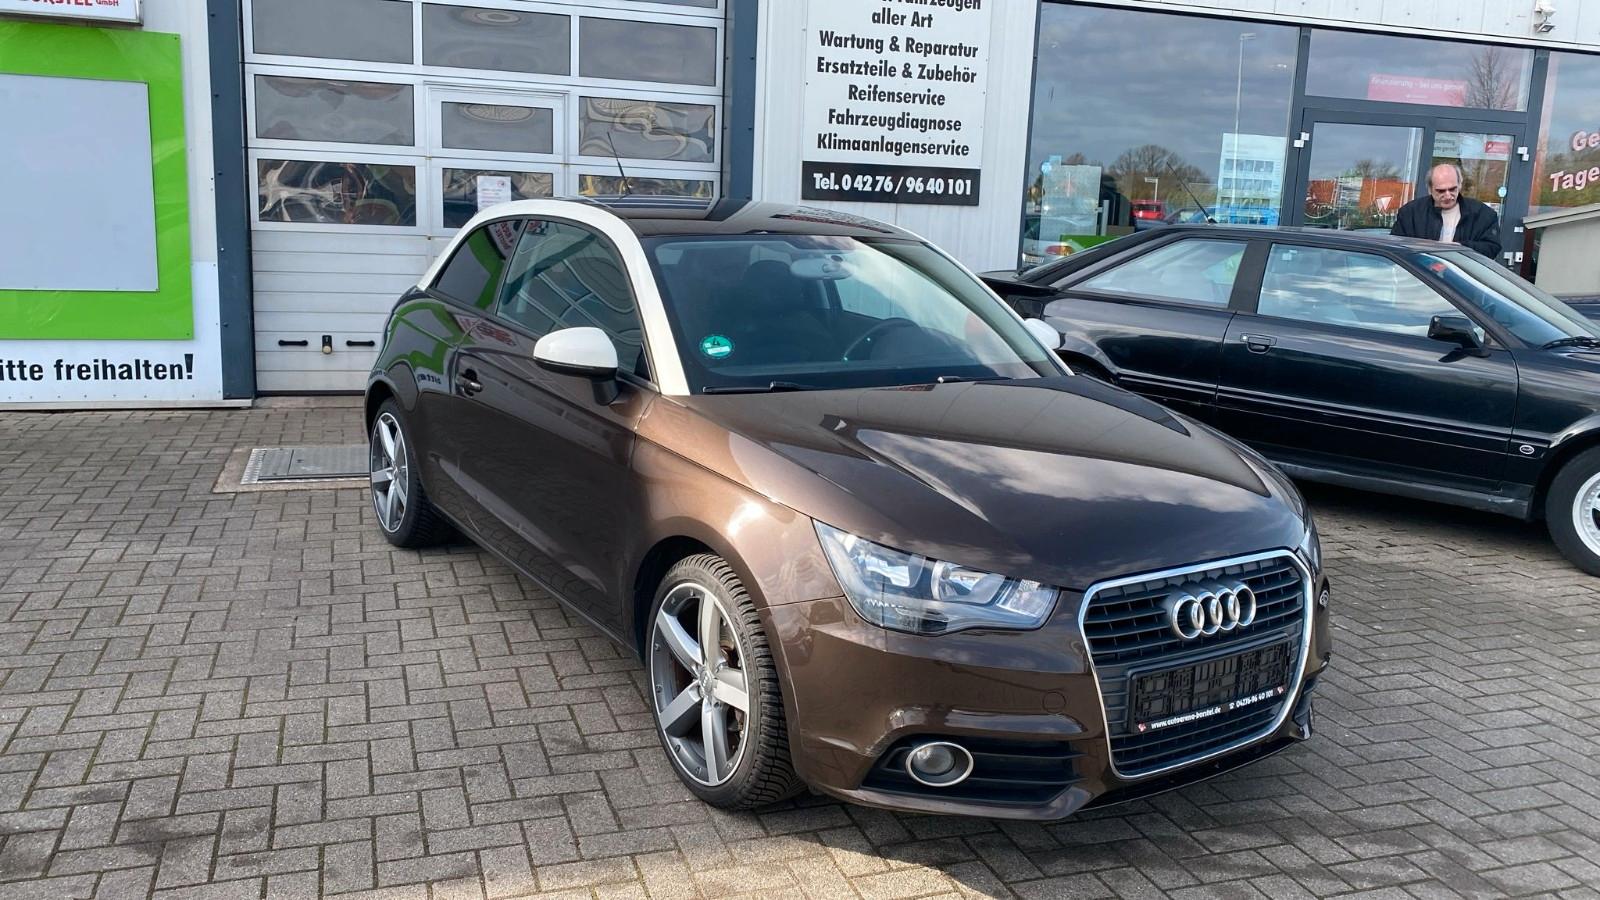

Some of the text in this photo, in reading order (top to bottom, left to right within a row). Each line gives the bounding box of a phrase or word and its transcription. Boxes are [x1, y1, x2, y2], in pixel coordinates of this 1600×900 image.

[872, 7, 934, 28] aller Art
[819, 30, 978, 58] Wartung & Reparatur
[817, 56, 977, 83] Ersatzteile & Zubehör
[848, 84, 946, 106] Reifenservice
[828, 108, 962, 133] Fahrzeugdiagnose
[817, 132, 970, 156] Klimaanlagenservice
[813, 172, 840, 191] Tel.
[1550, 166, 1600, 193] Tage
[54, 353, 194, 381] freihalten!
